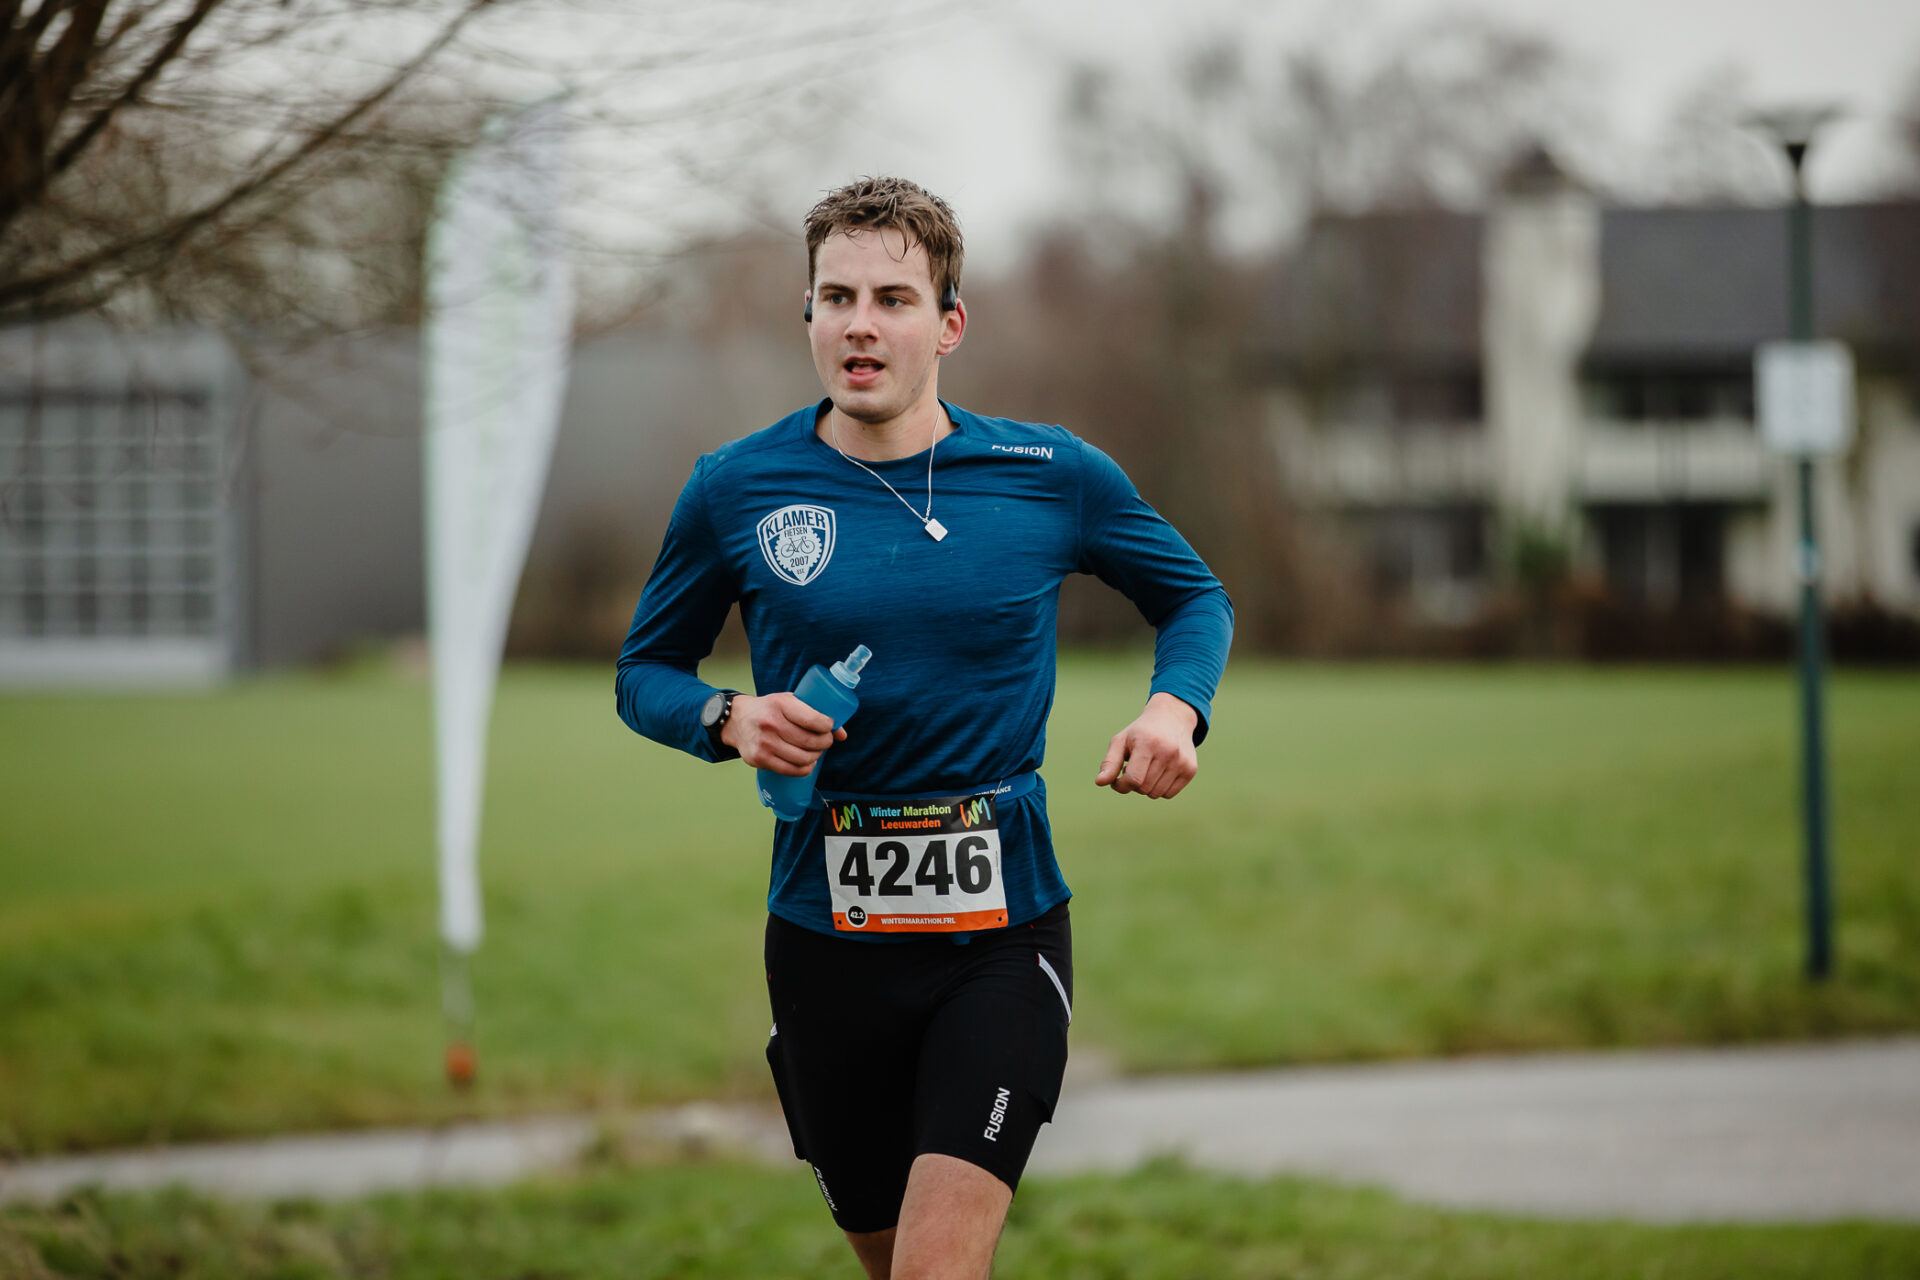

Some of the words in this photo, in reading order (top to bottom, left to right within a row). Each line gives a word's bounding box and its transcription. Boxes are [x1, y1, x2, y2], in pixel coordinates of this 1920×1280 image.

[765, 510, 826, 539] KLAMER
[784, 527, 808, 538] FIETSEN
[790, 556, 809, 568] 2007
[869, 805, 901, 817] Winter
[903, 804, 952, 817] Marathon
[881, 818, 941, 830] Leeuwarden
[839, 835, 992, 897] 4246
[850, 911, 865, 920] 42.2
[880, 917, 957, 925] WINTERMARATHON.FRL
[983, 1086, 1011, 1142] FUSION
